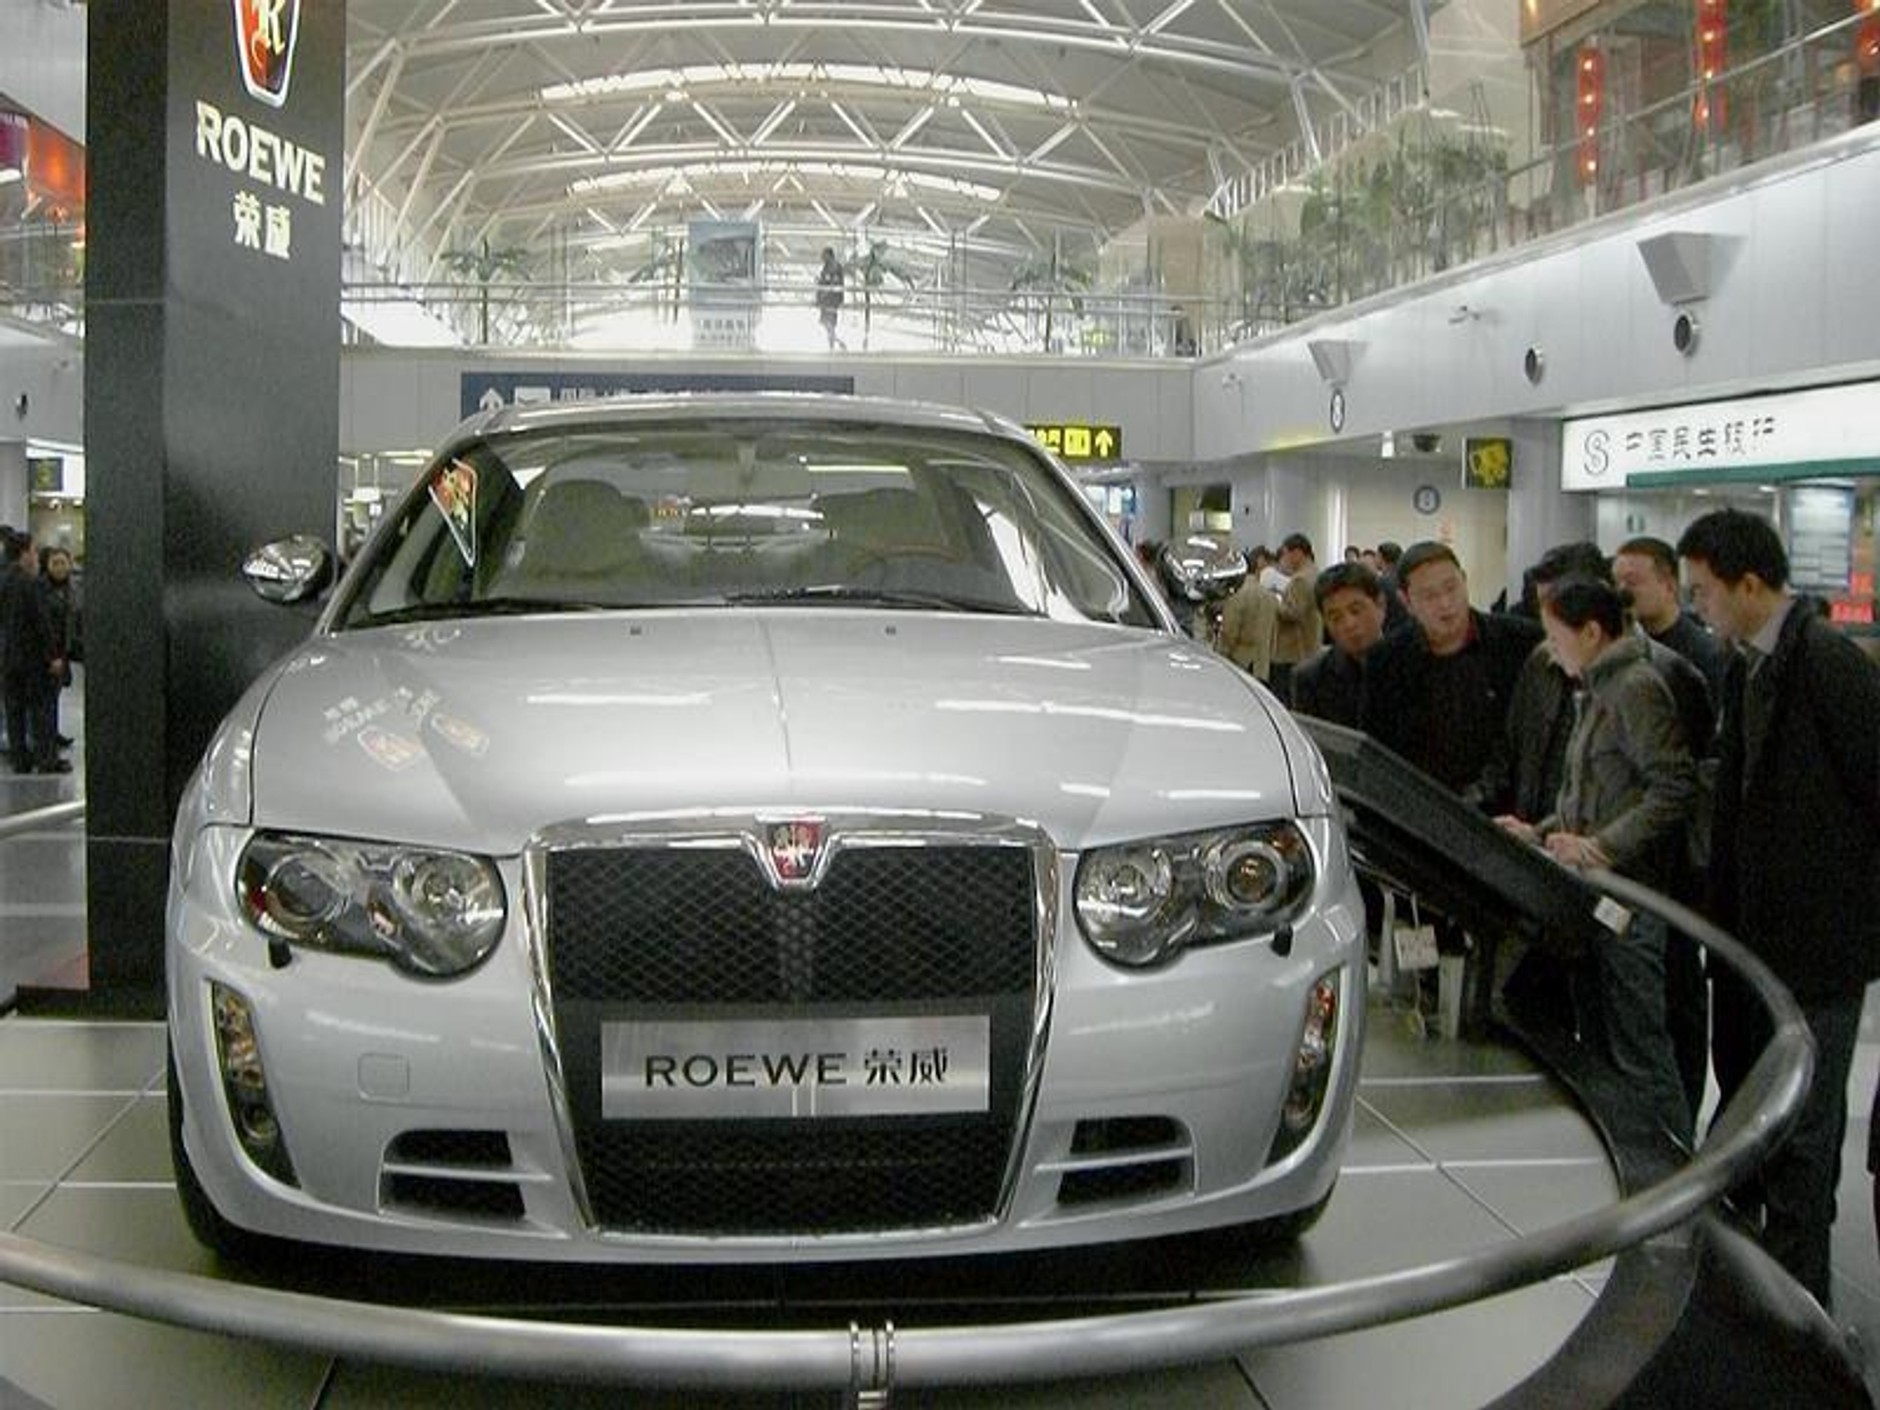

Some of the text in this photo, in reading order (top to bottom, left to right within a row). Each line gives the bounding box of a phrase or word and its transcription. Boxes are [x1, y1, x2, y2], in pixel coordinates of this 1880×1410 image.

[197, 100, 325, 205] ROEWE
[645, 1047, 948, 1087] ROEWE 荣威
